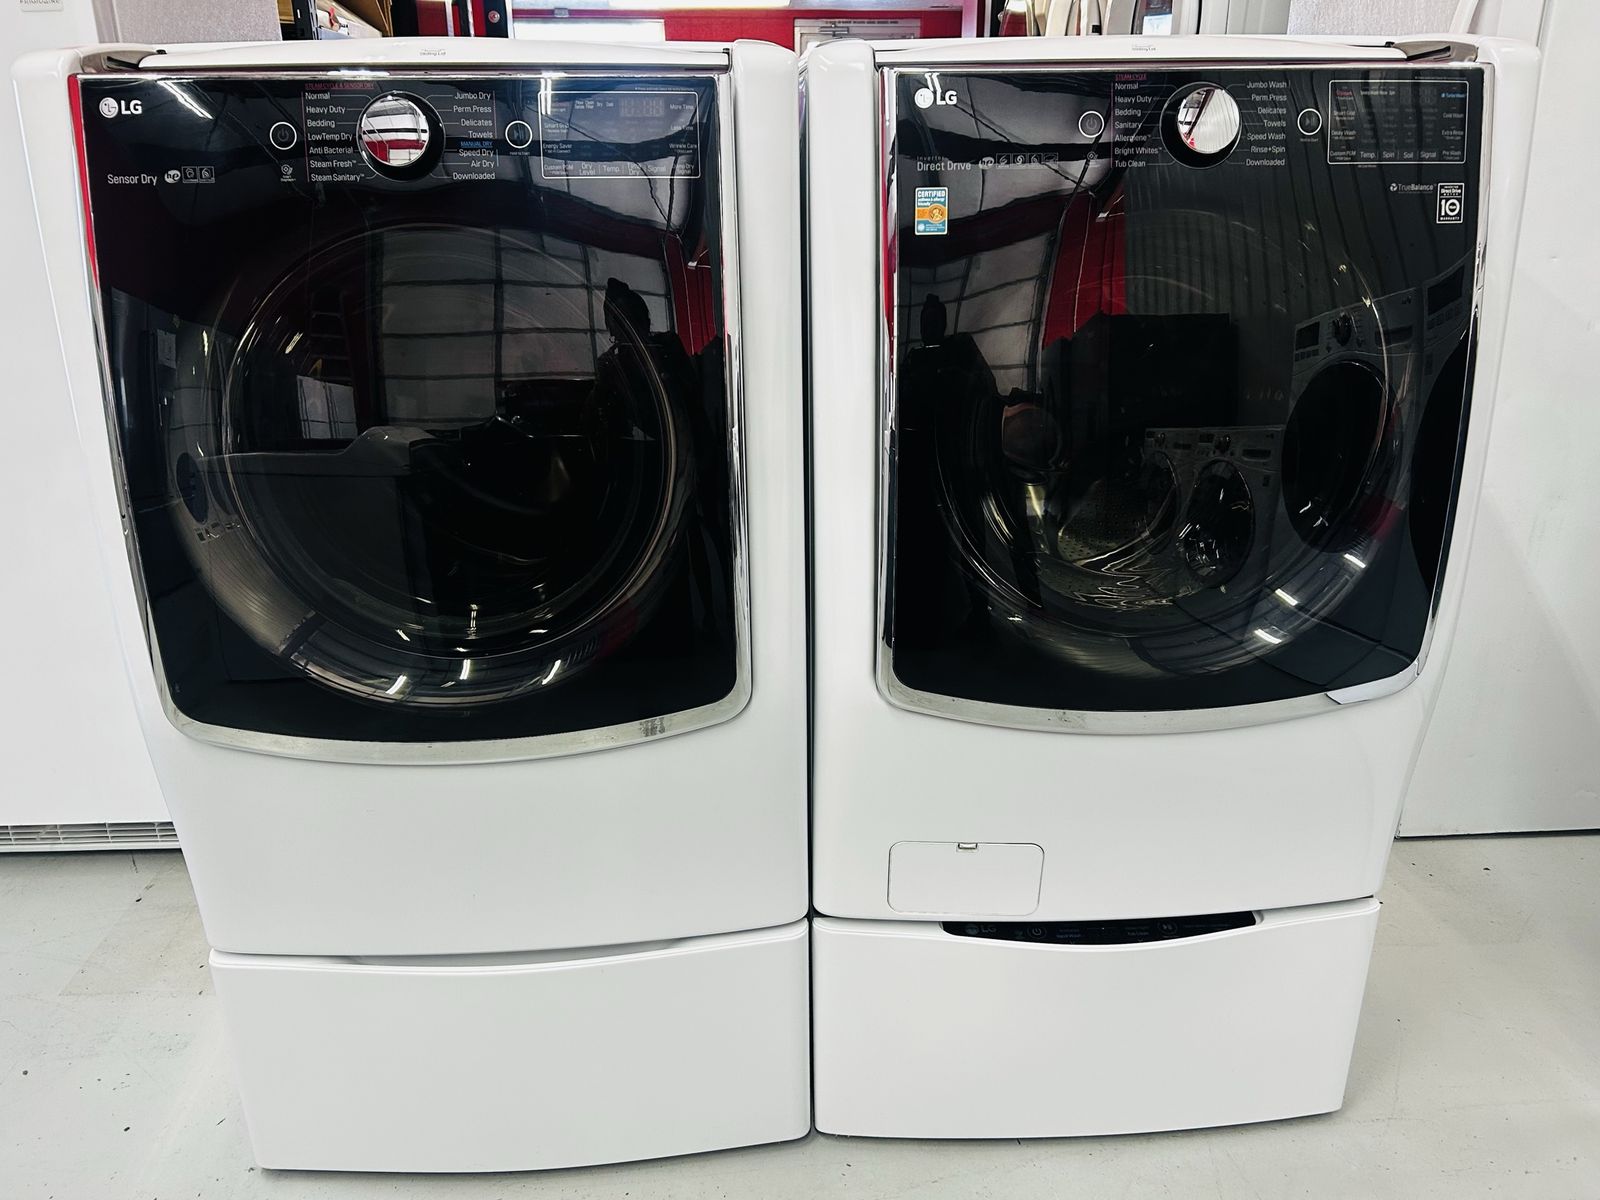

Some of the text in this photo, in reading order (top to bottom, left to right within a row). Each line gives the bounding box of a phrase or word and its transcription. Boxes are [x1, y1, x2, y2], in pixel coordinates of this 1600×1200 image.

[454, 92, 490, 100] Jumbo Dry
[936, 90, 957, 105] LG
[121, 100, 142, 114] LG
[306, 106, 345, 114] Heavy Duty
[1115, 109, 1141, 117] Bedding
[307, 120, 335, 128] Bedding
[341, 133, 352, 141] Dry
[1247, 133, 1266, 141] Speed
[459, 149, 494, 157] Speed Dry
[310, 160, 332, 168] Steam
[482, 160, 494, 168] Dry
[582, 162, 592, 170] Dry
[917, 161, 945, 171] Direct
[948, 161, 971, 170] Drive
[108, 174, 139, 184] Sensor
[141, 174, 157, 186] Dry
[1441, 199, 1460, 216] 10
